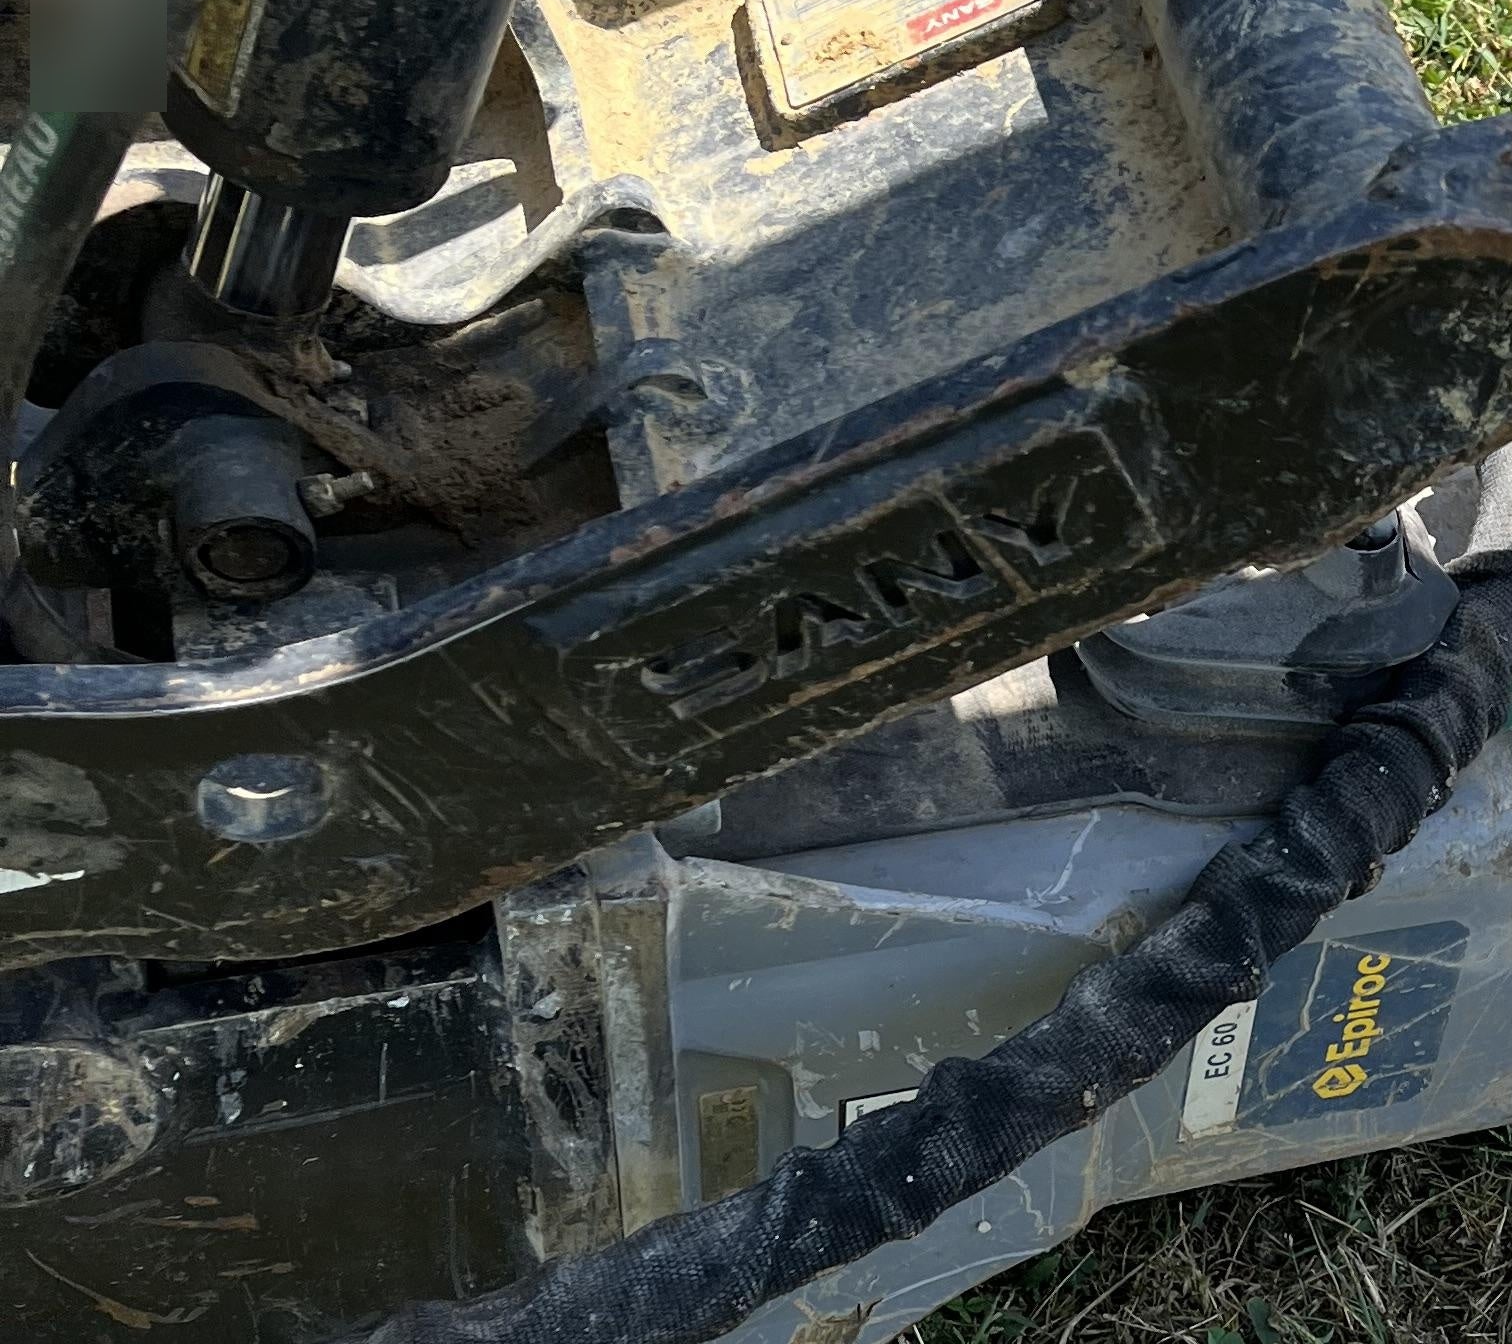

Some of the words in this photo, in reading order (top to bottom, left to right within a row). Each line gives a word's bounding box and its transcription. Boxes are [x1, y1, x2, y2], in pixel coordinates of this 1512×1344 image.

[640, 471, 1076, 722] SANY
[1212, 1021, 1238, 1047] 60
[1325, 952, 1392, 1063] Epiroc
[1204, 1049, 1233, 1081] EC
